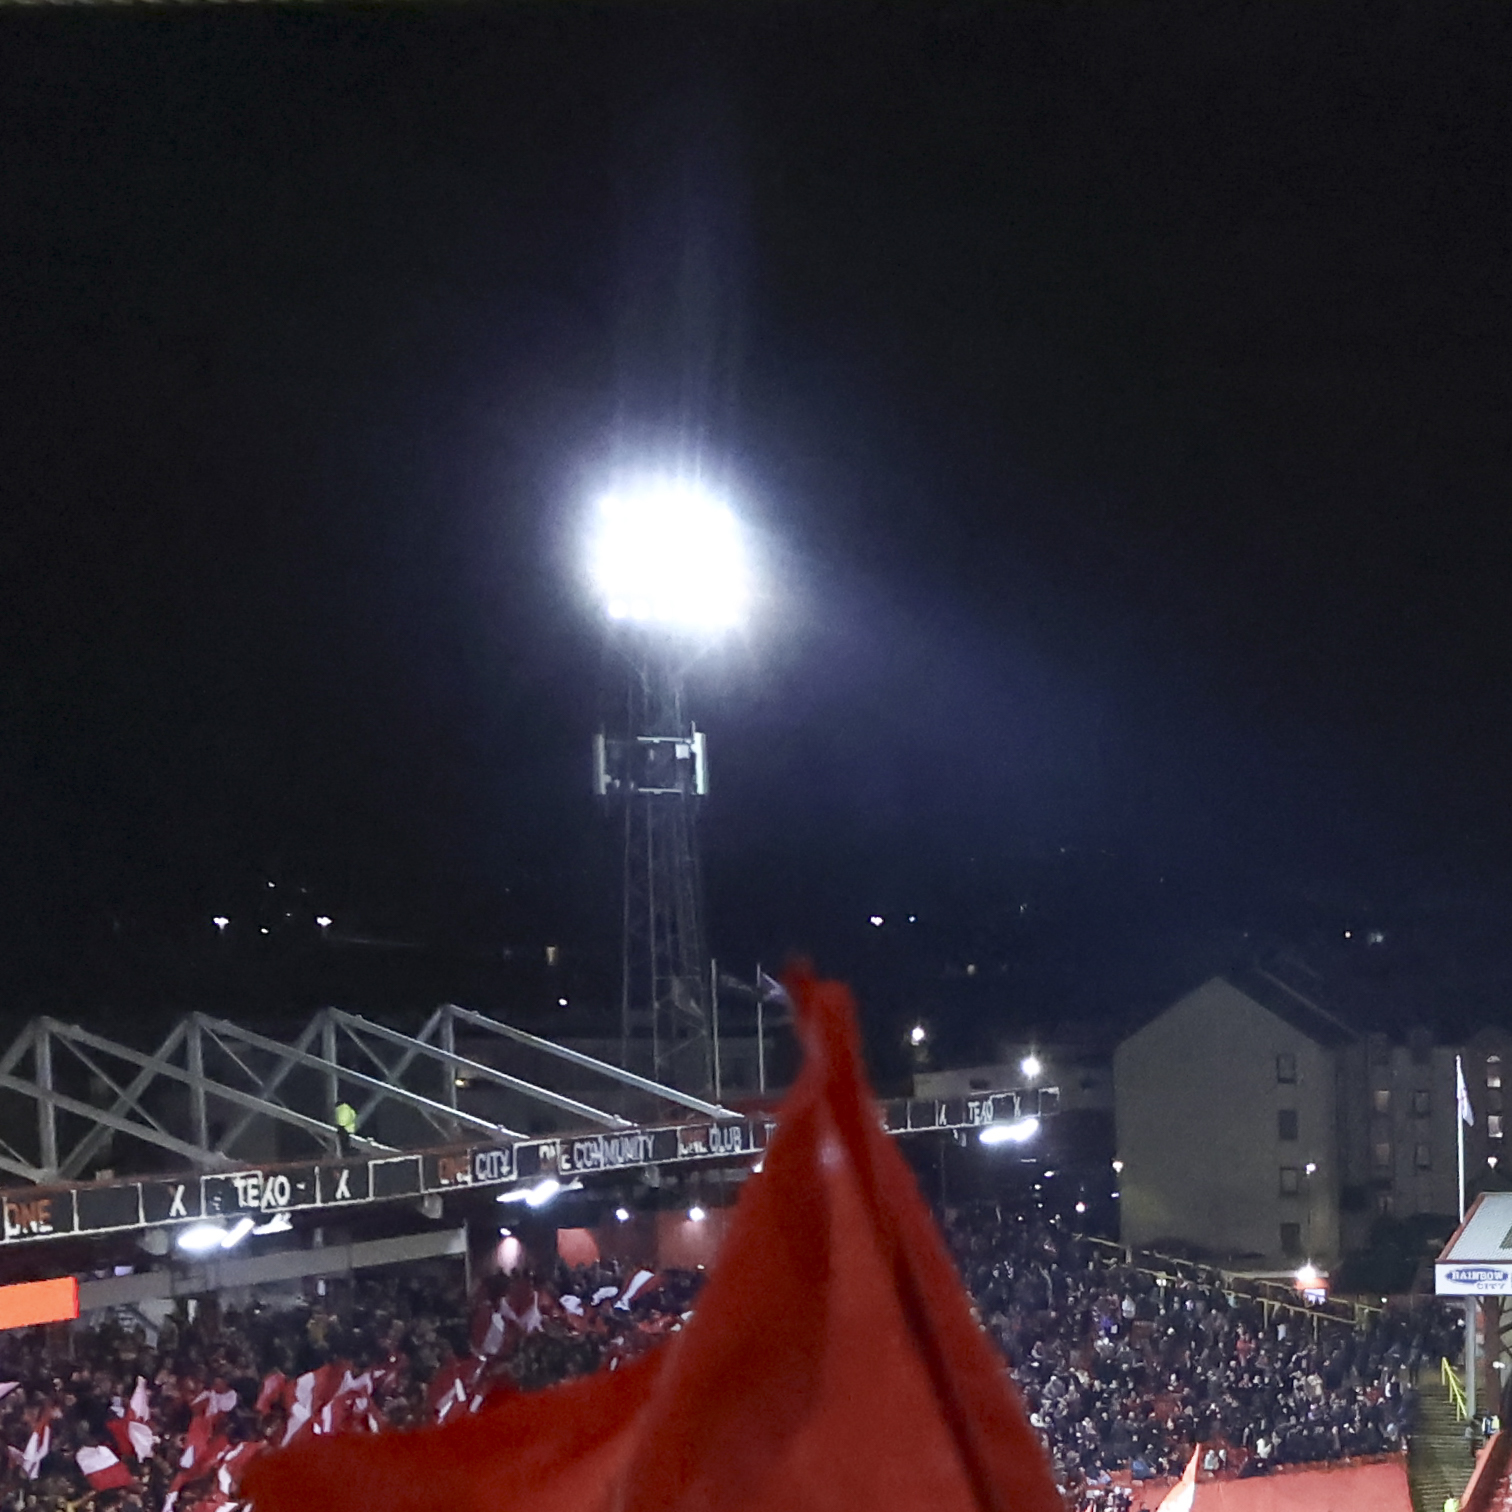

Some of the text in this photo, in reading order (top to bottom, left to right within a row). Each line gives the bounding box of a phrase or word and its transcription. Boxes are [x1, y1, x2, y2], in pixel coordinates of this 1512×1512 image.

[475, 1150, 511, 1181] CITY
[573, 1134, 655, 1169] COMMUNITY
[233, 1174, 291, 1208] TEXO
[1451, 1270, 1504, 1281] RAINBOW
